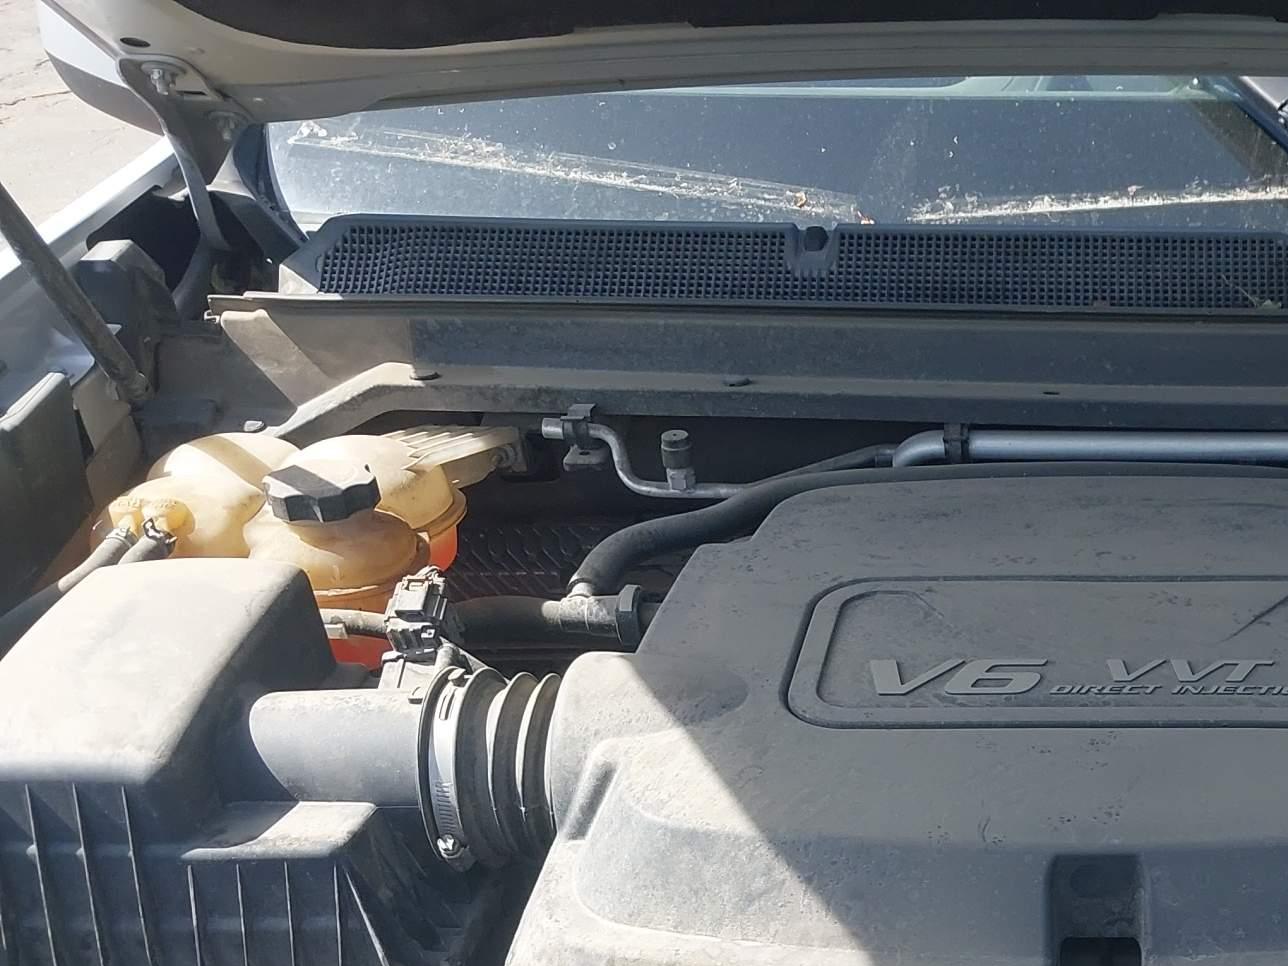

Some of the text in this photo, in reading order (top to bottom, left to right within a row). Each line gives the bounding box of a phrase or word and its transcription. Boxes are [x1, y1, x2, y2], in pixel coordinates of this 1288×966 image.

[869, 658, 1275, 696] V6 VVT
[1048, 684, 1163, 696] DIRECT
